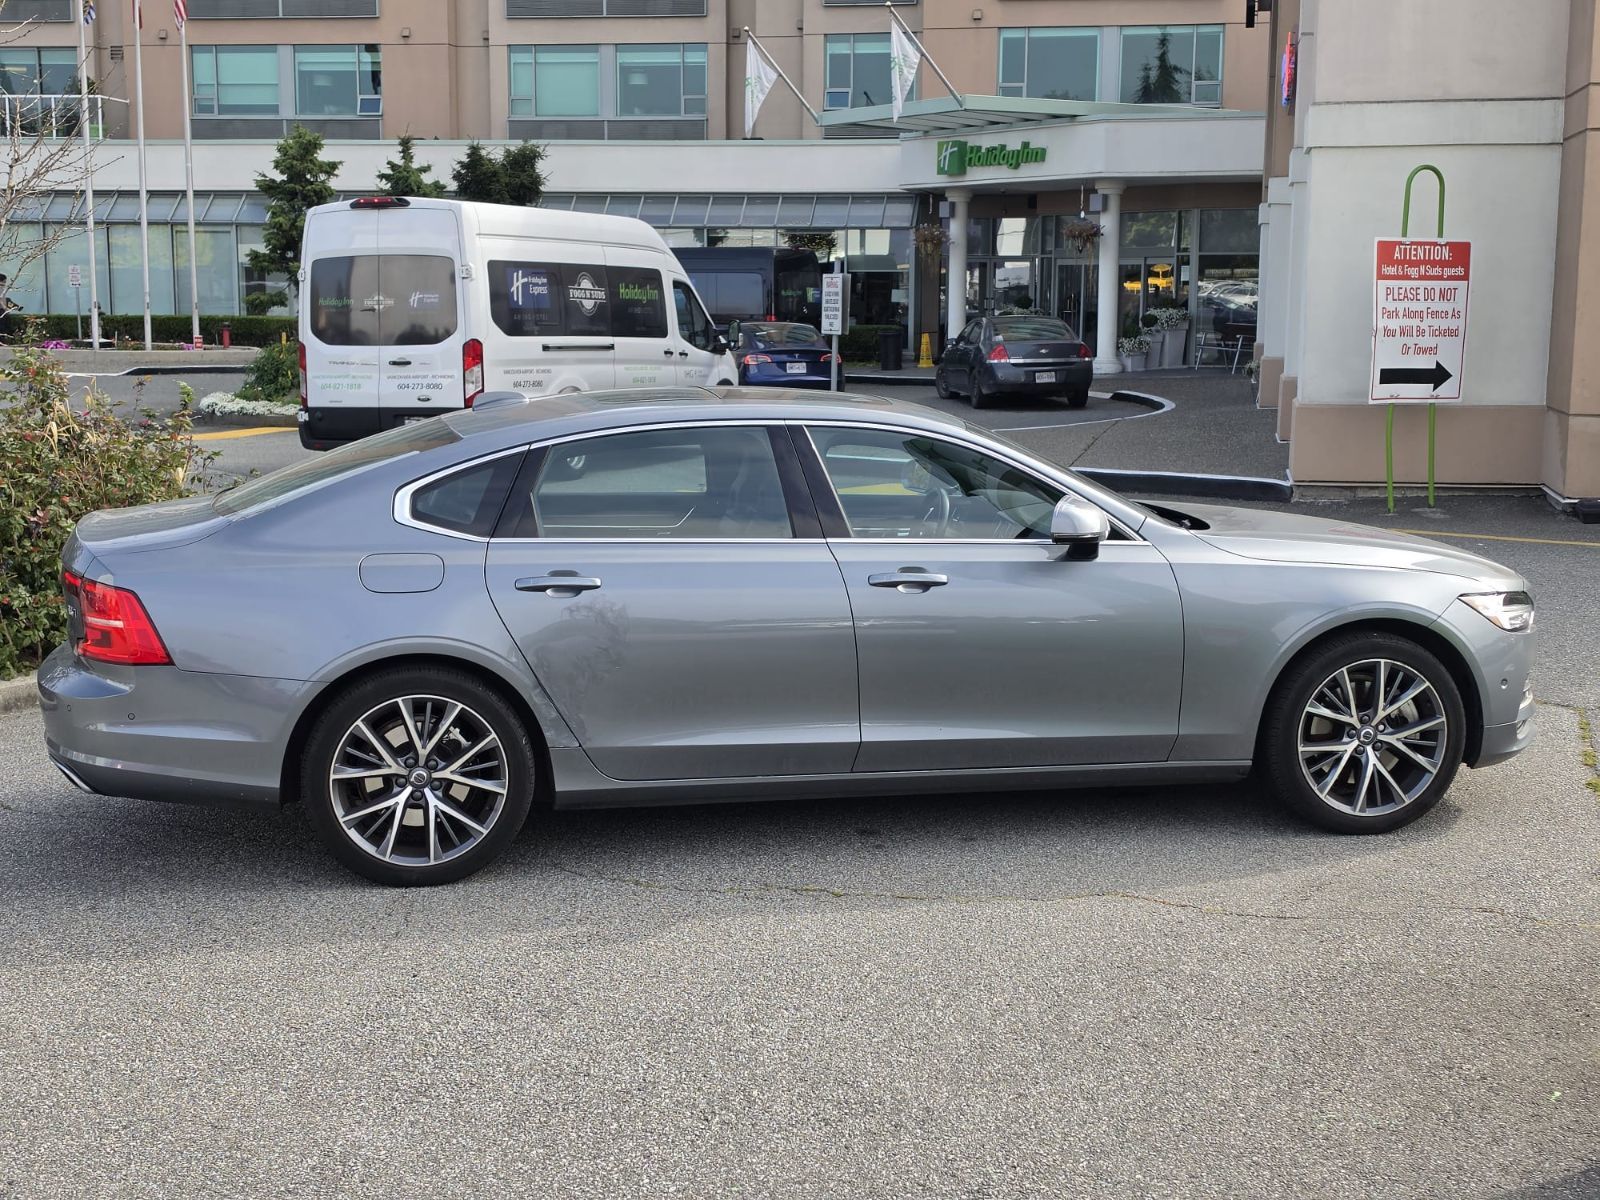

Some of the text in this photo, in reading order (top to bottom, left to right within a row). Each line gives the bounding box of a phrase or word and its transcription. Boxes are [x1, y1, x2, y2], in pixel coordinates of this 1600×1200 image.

[967, 142, 1047, 170] Holiday Inn
[1393, 245, 1453, 260] ATTENTION:
[1381, 264, 1465, 278] Hotel & Fogg N Suds guests
[529, 284, 548, 295] Express
[569, 289, 585, 298] FOGG
[619, 283, 659, 304] Holiday Inn
[1385, 287, 1459, 302] PLEASE DO NOT
[1382, 307, 1461, 323] Park Along Fence As
[1383, 325, 1460, 338] You Will Be Ticketed
[1401, 343, 1438, 355] Or Towed
[397, 382, 443, 390] 604-273-8080
